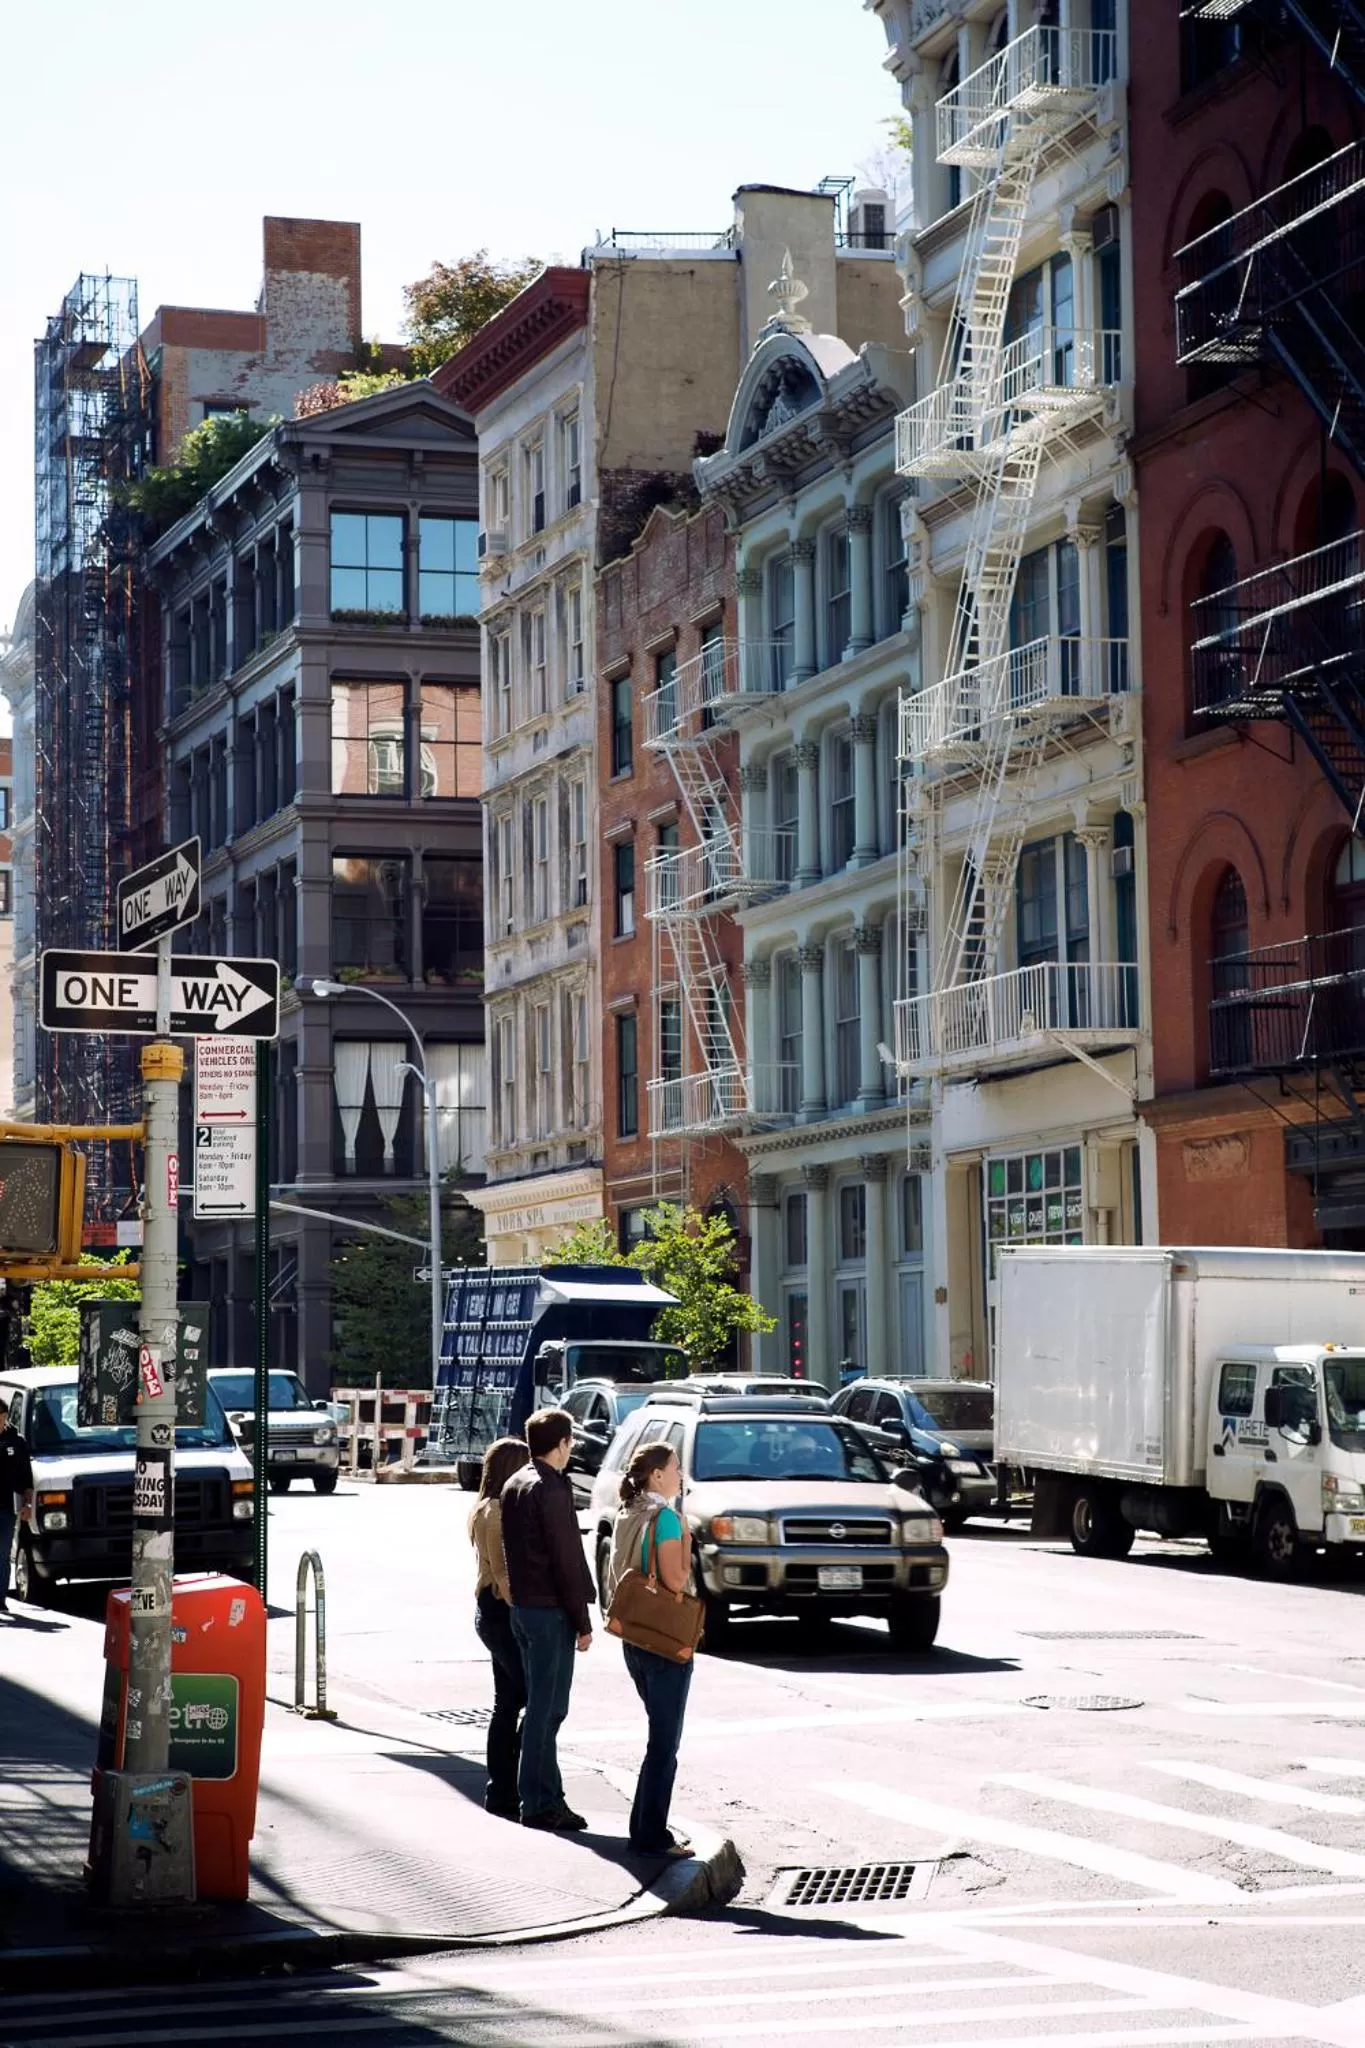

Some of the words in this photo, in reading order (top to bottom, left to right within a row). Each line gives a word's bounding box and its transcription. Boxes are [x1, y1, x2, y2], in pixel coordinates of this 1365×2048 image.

[124, 892, 151, 929] ONE
[165, 866, 191, 906] WAY
[63, 975, 139, 1008] ONE
[181, 980, 252, 1012] WAY
[199, 1045, 255, 1056] COMMERCIAL
[199, 1056, 238, 1066] VEHICLES
[240, 1056, 256, 1066] ONL
[199, 1070, 222, 1078] OTHERS
[223, 1070, 233, 1078] NO
[199, 1083, 223, 1092] Monday
[229, 1082, 249, 1091] Friday
[198, 1127, 210, 1147] 2
[199, 1152, 224, 1161] Monday
[231, 1151, 252, 1160] Friday
[198, 1174, 228, 1183] Saturday
[498, 1211, 524, 1232] YORK
[526, 1206, 545, 1226] SPA
